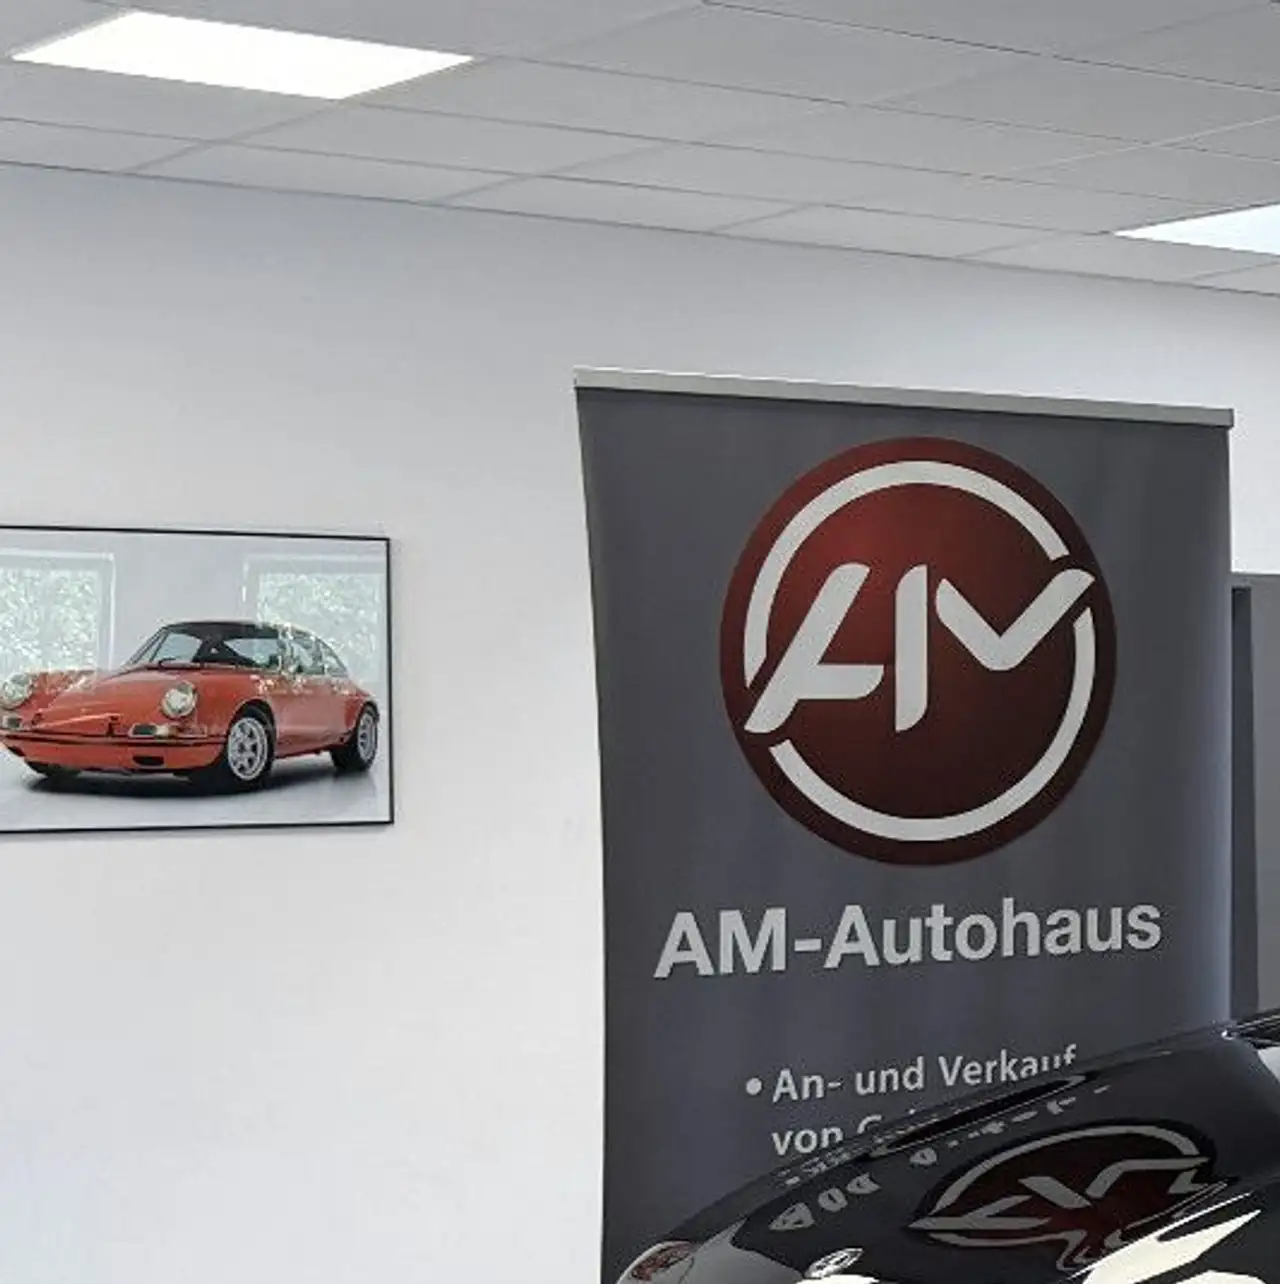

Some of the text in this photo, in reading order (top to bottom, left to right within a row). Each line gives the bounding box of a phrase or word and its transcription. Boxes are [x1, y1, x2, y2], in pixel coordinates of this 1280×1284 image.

[744, 563, 1096, 733] AM
[653, 898, 1161, 979] AM-Autohaus
[772, 1067, 842, 1104] An-
[855, 1056, 924, 1096] und
[771, 1126, 844, 1156] von
